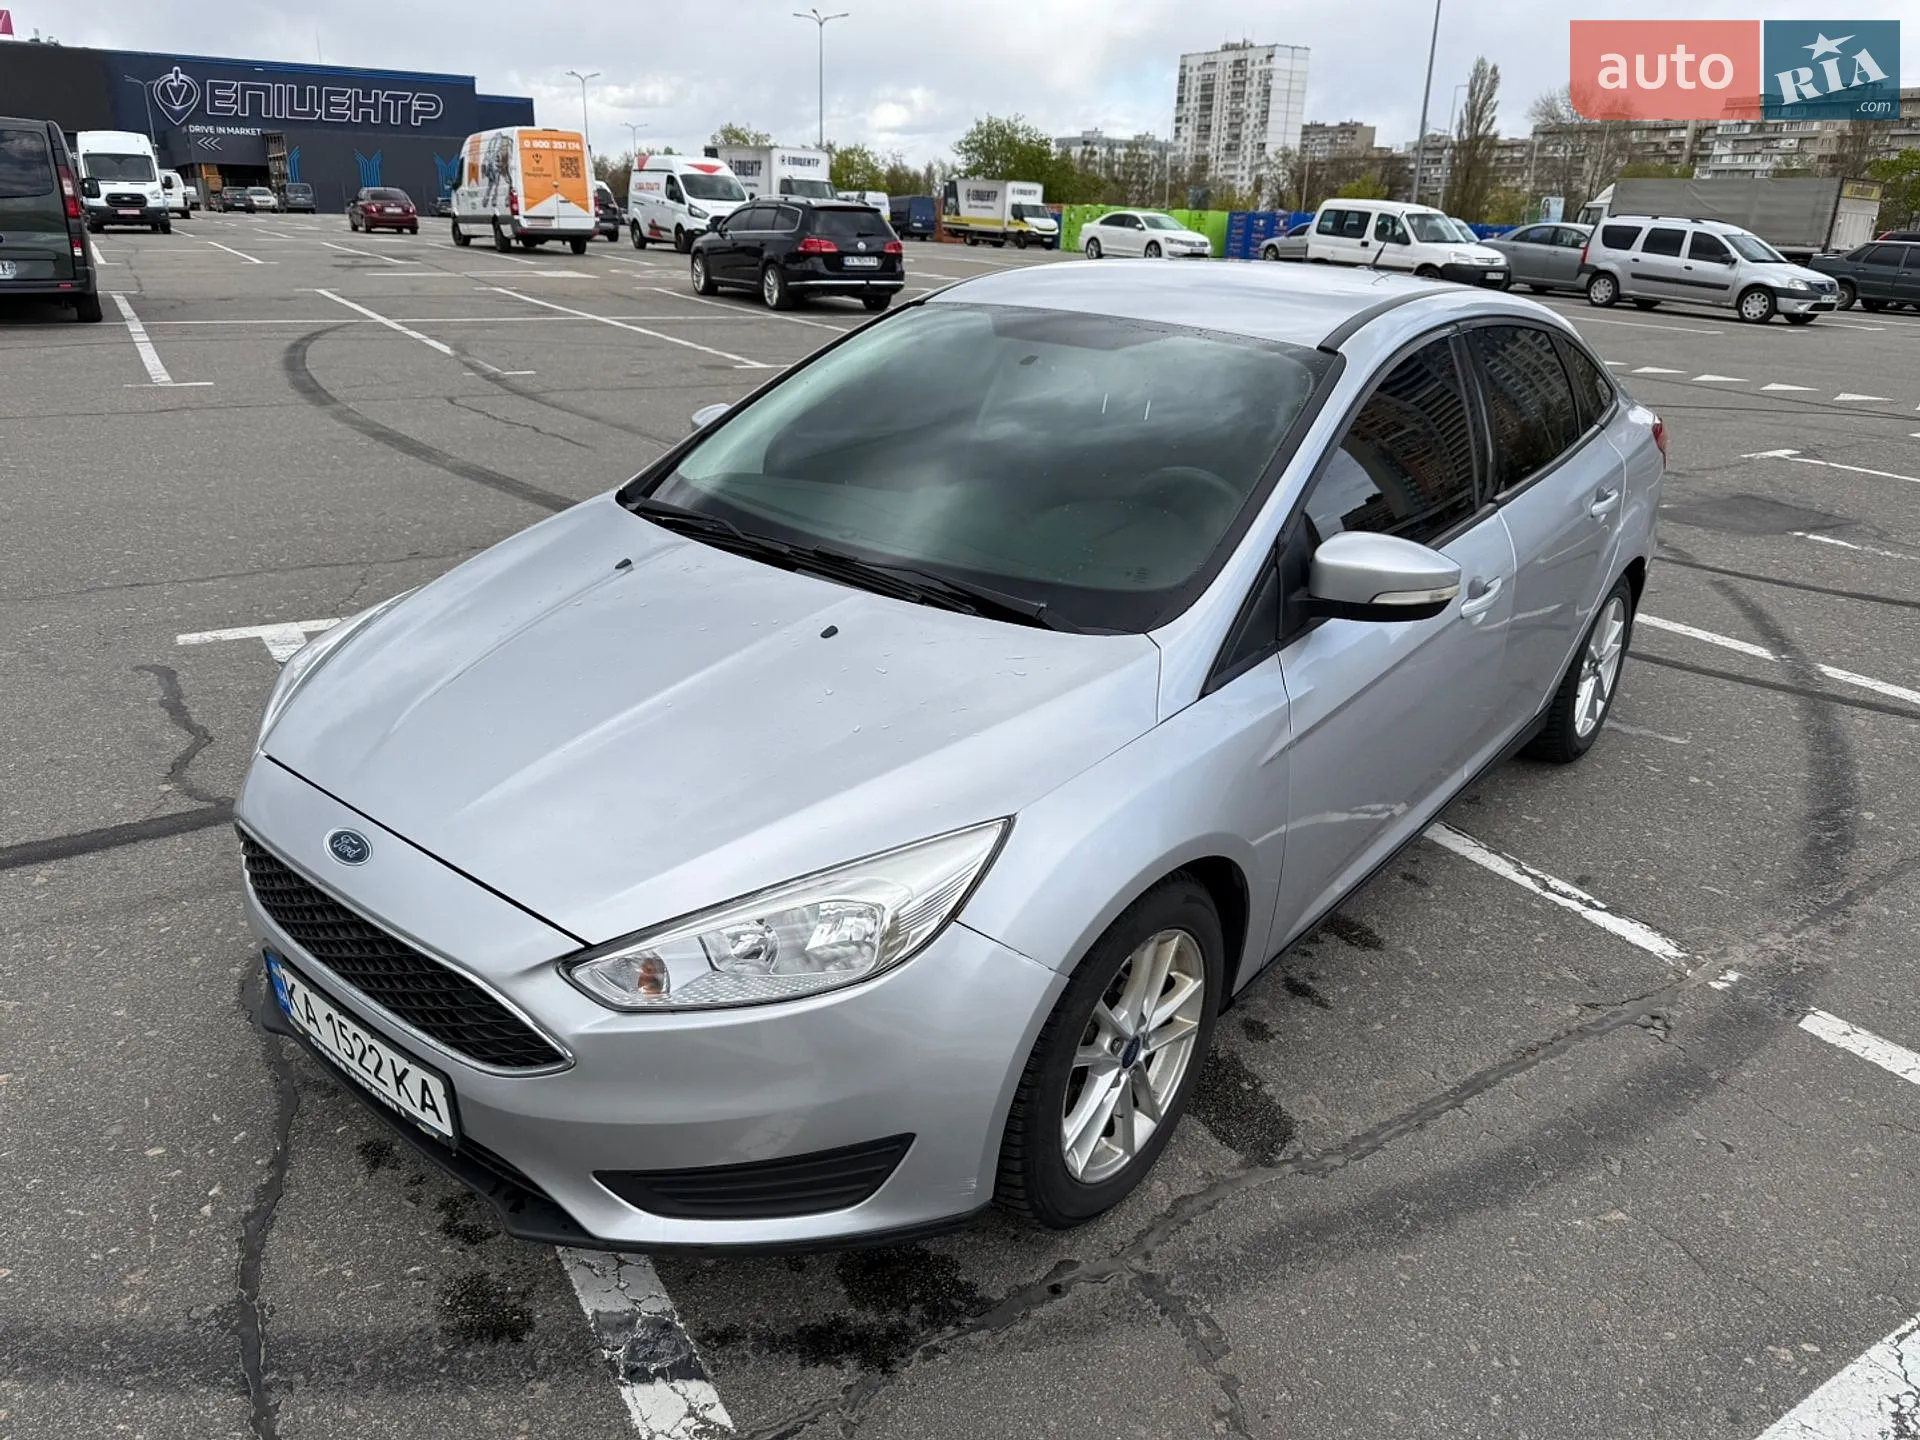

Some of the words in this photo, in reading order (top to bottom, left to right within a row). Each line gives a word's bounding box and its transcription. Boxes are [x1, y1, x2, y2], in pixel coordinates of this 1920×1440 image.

[206, 79, 443, 126] ЕПІЦЕНТР
[188, 124, 215, 134] DRIVE
[216, 126, 226, 134] IN
[226, 126, 262, 136] MARKET
[333, 834, 362, 859] Ford
[325, 1012, 390, 1087] 1522
[390, 1057, 444, 1124] KA
